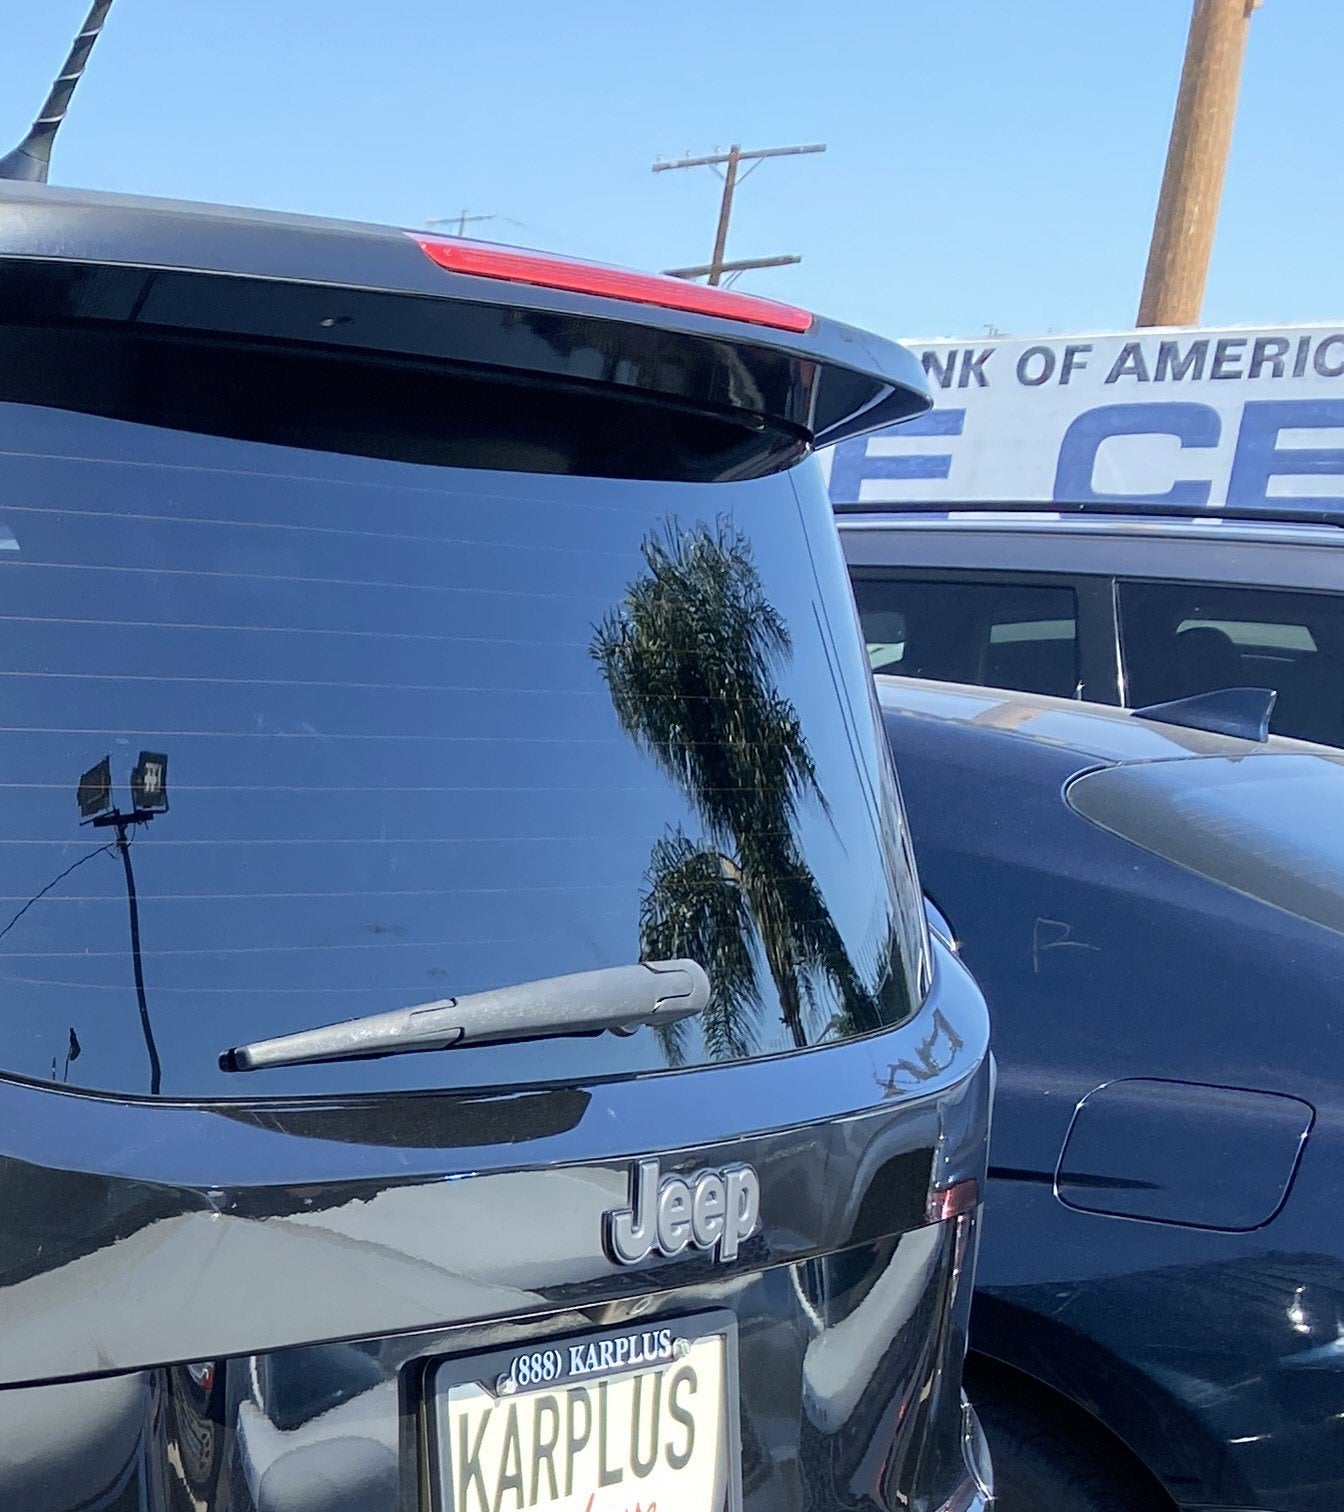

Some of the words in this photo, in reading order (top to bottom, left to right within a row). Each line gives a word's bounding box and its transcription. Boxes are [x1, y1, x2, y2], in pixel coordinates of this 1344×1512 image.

[921, 348, 996, 388] NK
[1016, 343, 1092, 386] OF
[1105, 334, 1344, 385] AMERIC
[828, 407, 967, 520] E
[1052, 398, 1344, 523] CE
[601, 1157, 760, 1266] Jeep
[511, 1350, 562, 1386] (888)
[569, 1329, 671, 1377] KARPLUS
